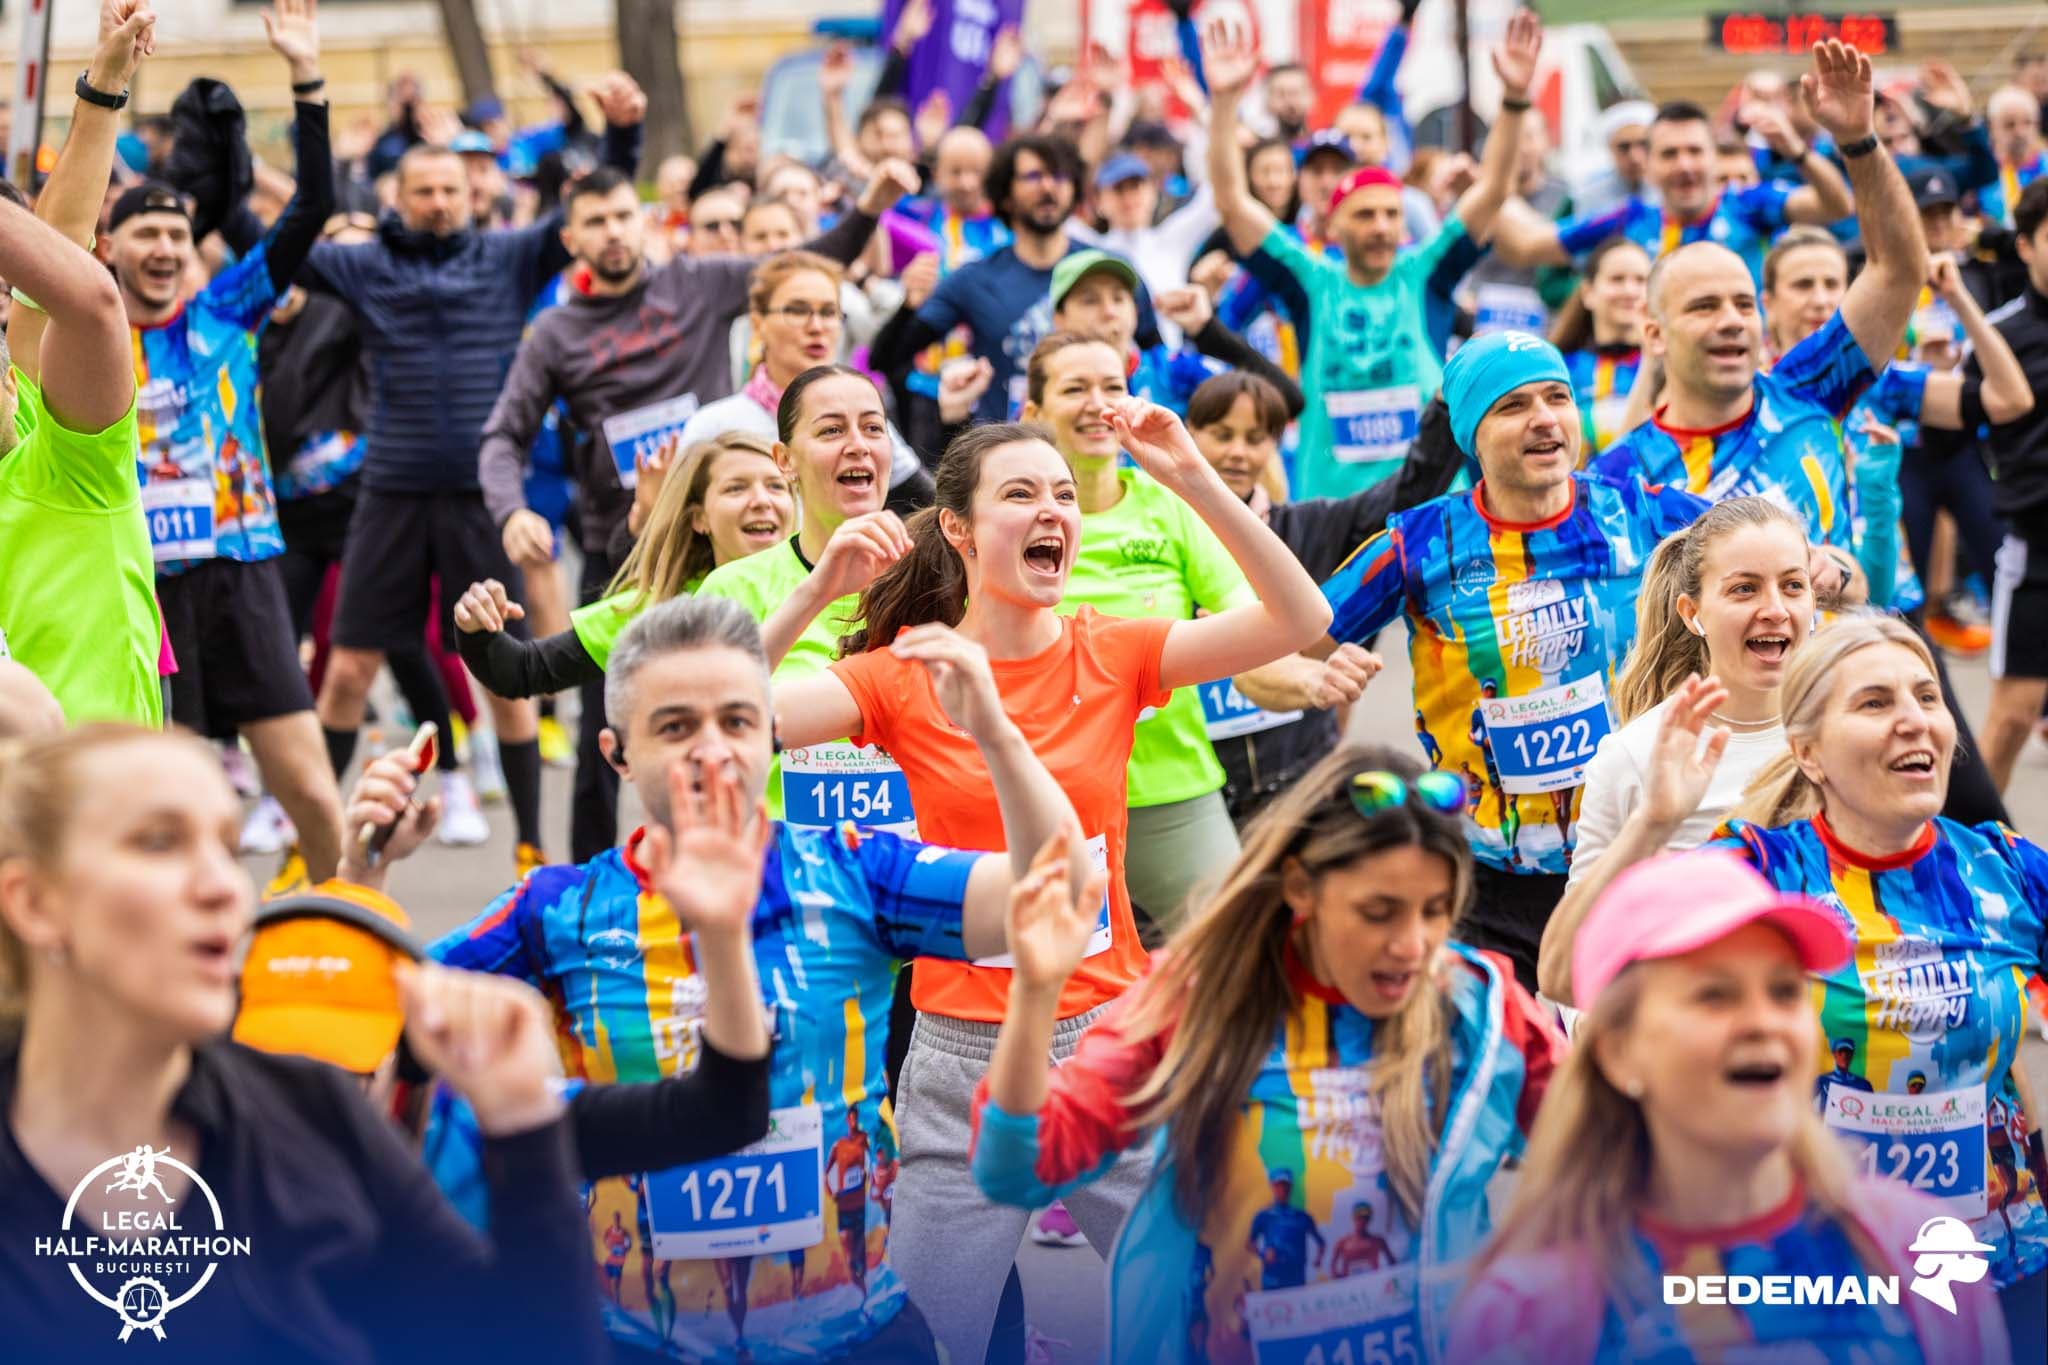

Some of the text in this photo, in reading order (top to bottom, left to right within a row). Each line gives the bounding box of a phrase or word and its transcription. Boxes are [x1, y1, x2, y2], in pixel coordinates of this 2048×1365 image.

[1497, 596, 1586, 648] LEGALLY
[1511, 629, 1585, 668] Happy
[1510, 698, 1558, 714] LEGAL
[815, 751, 866, 761] LEGAL
[1513, 718, 1595, 768] 1222
[811, 779, 893, 818] 1154
[1860, 959, 1969, 1002] LEGALLY
[1876, 996, 1967, 1030] Happy
[1871, 1103, 1934, 1118] LEGAL
[1860, 1139, 1960, 1188] 1223
[680, 1161, 788, 1222] 1271
